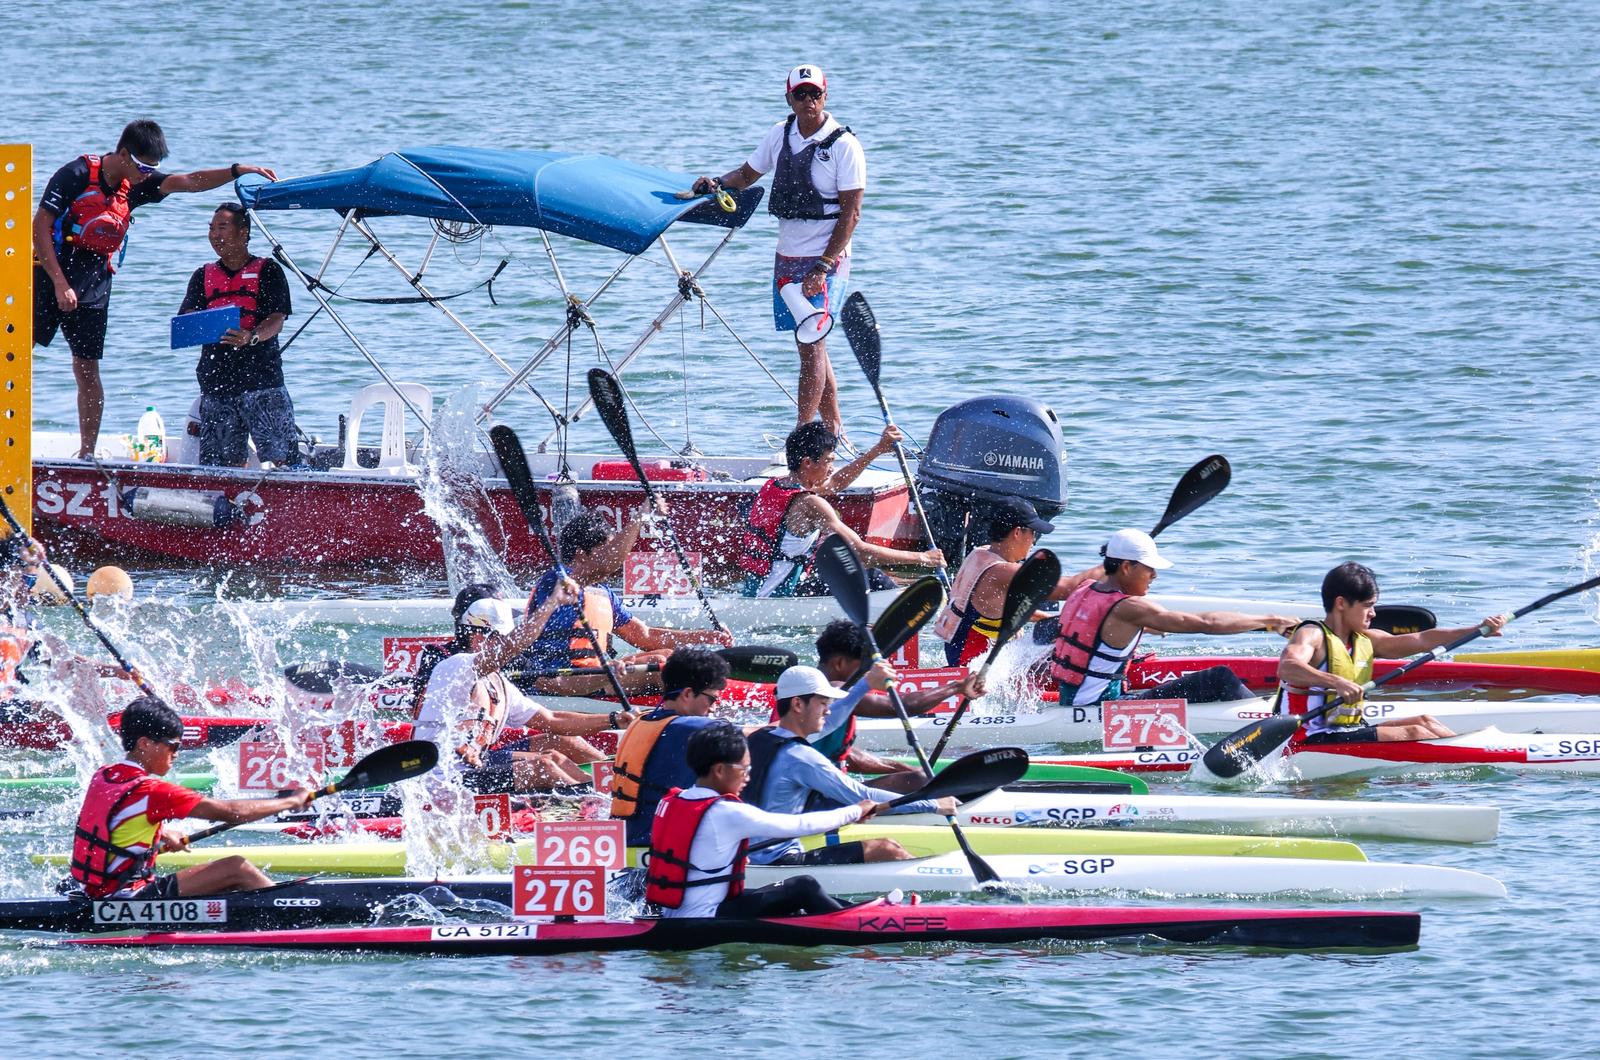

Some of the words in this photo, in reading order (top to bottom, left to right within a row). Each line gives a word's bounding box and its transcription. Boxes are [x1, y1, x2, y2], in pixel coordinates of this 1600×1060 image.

[998, 454, 1044, 470] YAMAHA
[1363, 704, 1395, 718] GP
[969, 716, 1016, 726] 4383
[1110, 712, 1181, 744] 273
[1138, 752, 1170, 763] CA
[970, 815, 1012, 825] NELO
[1046, 807, 1096, 820] SGP
[543, 835, 617, 869] 269
[1063, 858, 1115, 875] SGP
[524, 879, 594, 912] 276
[97, 901, 136, 922] CA
[141, 901, 199, 921] 4108
[437, 926, 471, 938] CA
[479, 925, 530, 937] 5121
[858, 916, 947, 931] KAPE
